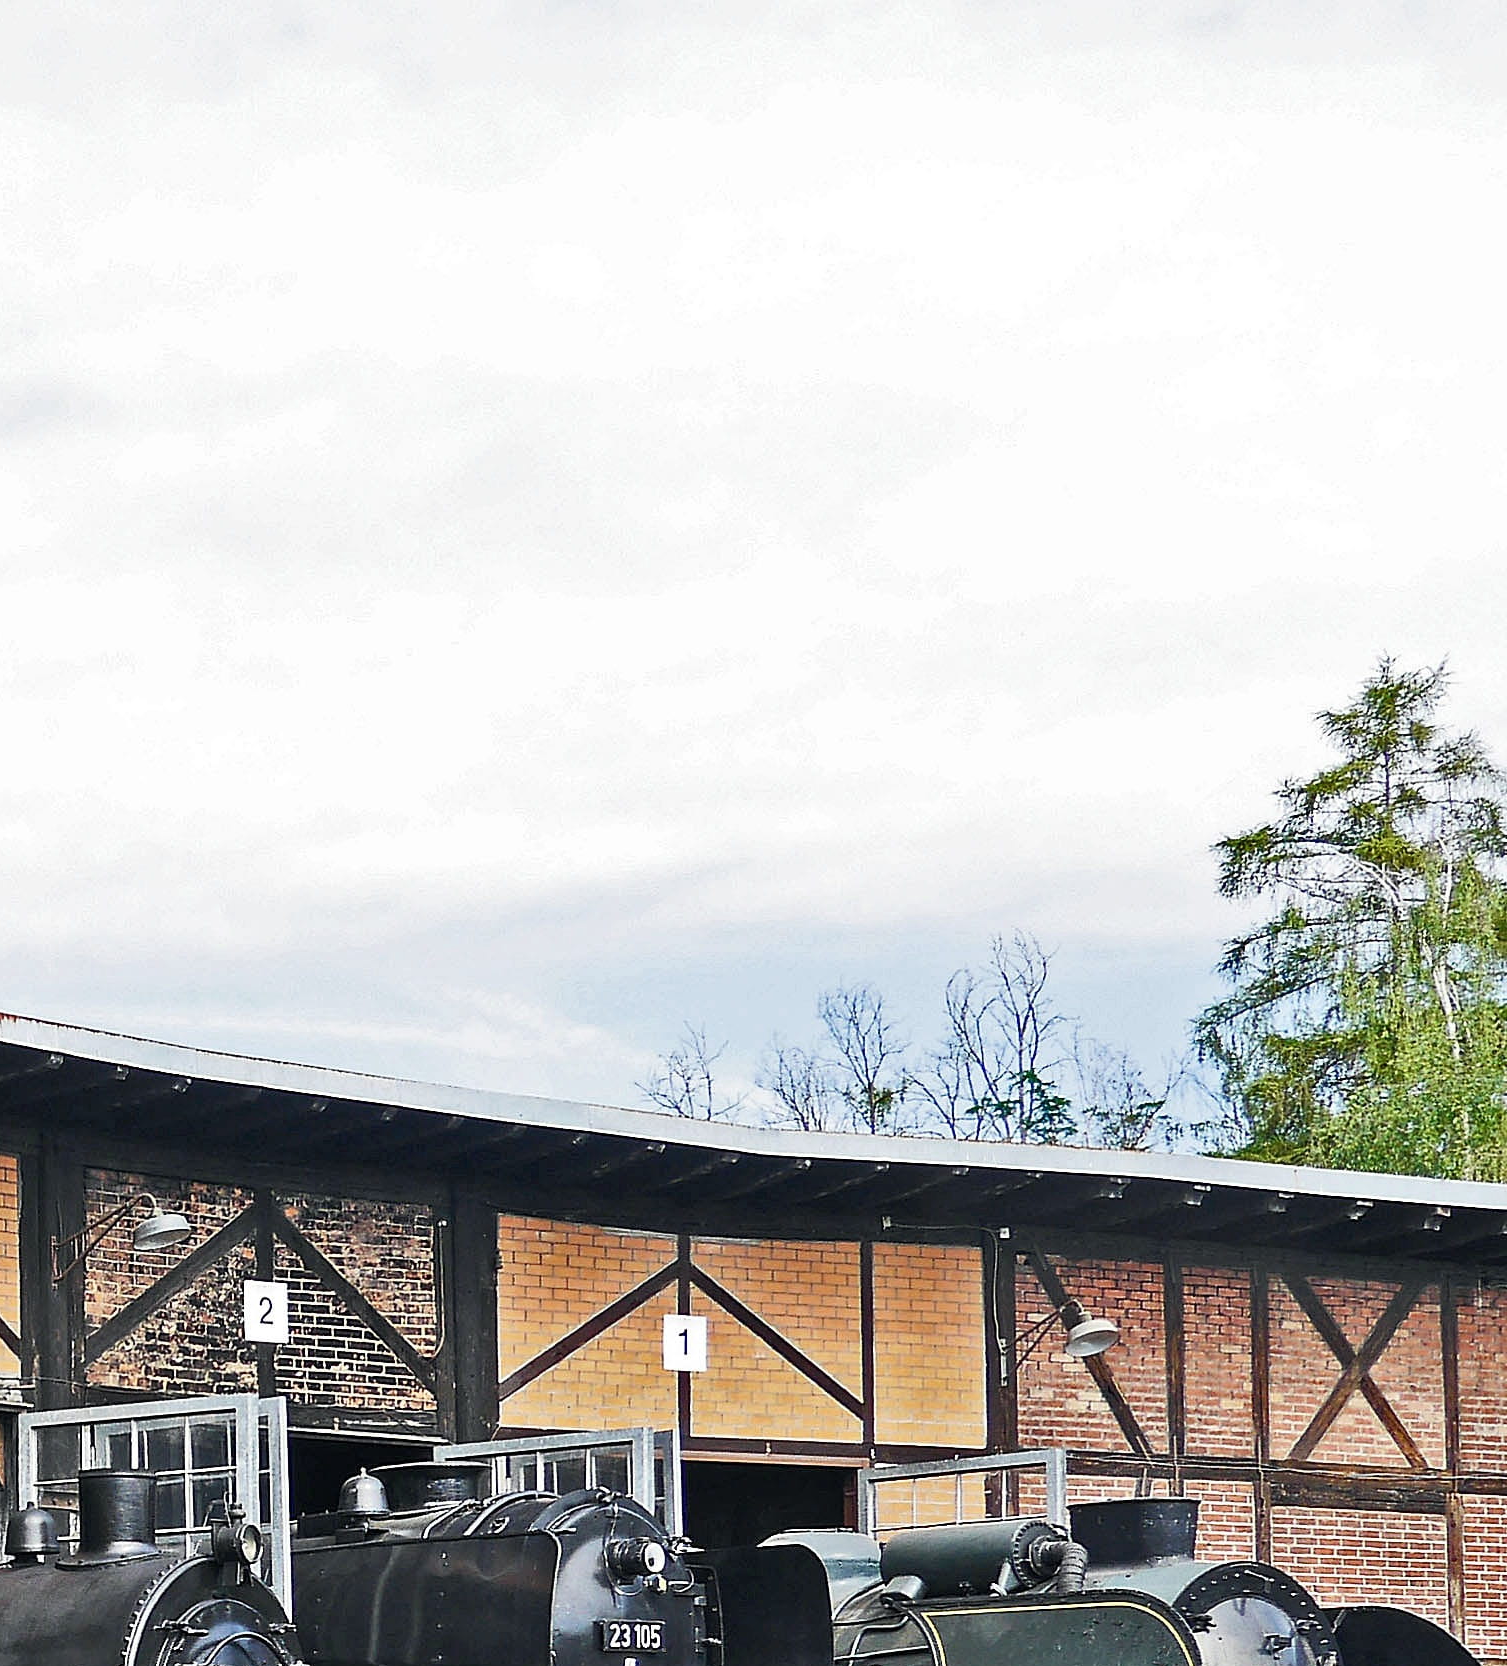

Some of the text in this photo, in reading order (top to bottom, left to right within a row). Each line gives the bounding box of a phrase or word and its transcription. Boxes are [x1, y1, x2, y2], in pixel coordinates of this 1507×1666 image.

[259, 1296, 274, 1325] 2
[678, 1328, 688, 1356] 1
[609, 1623, 661, 1649] 23 105
